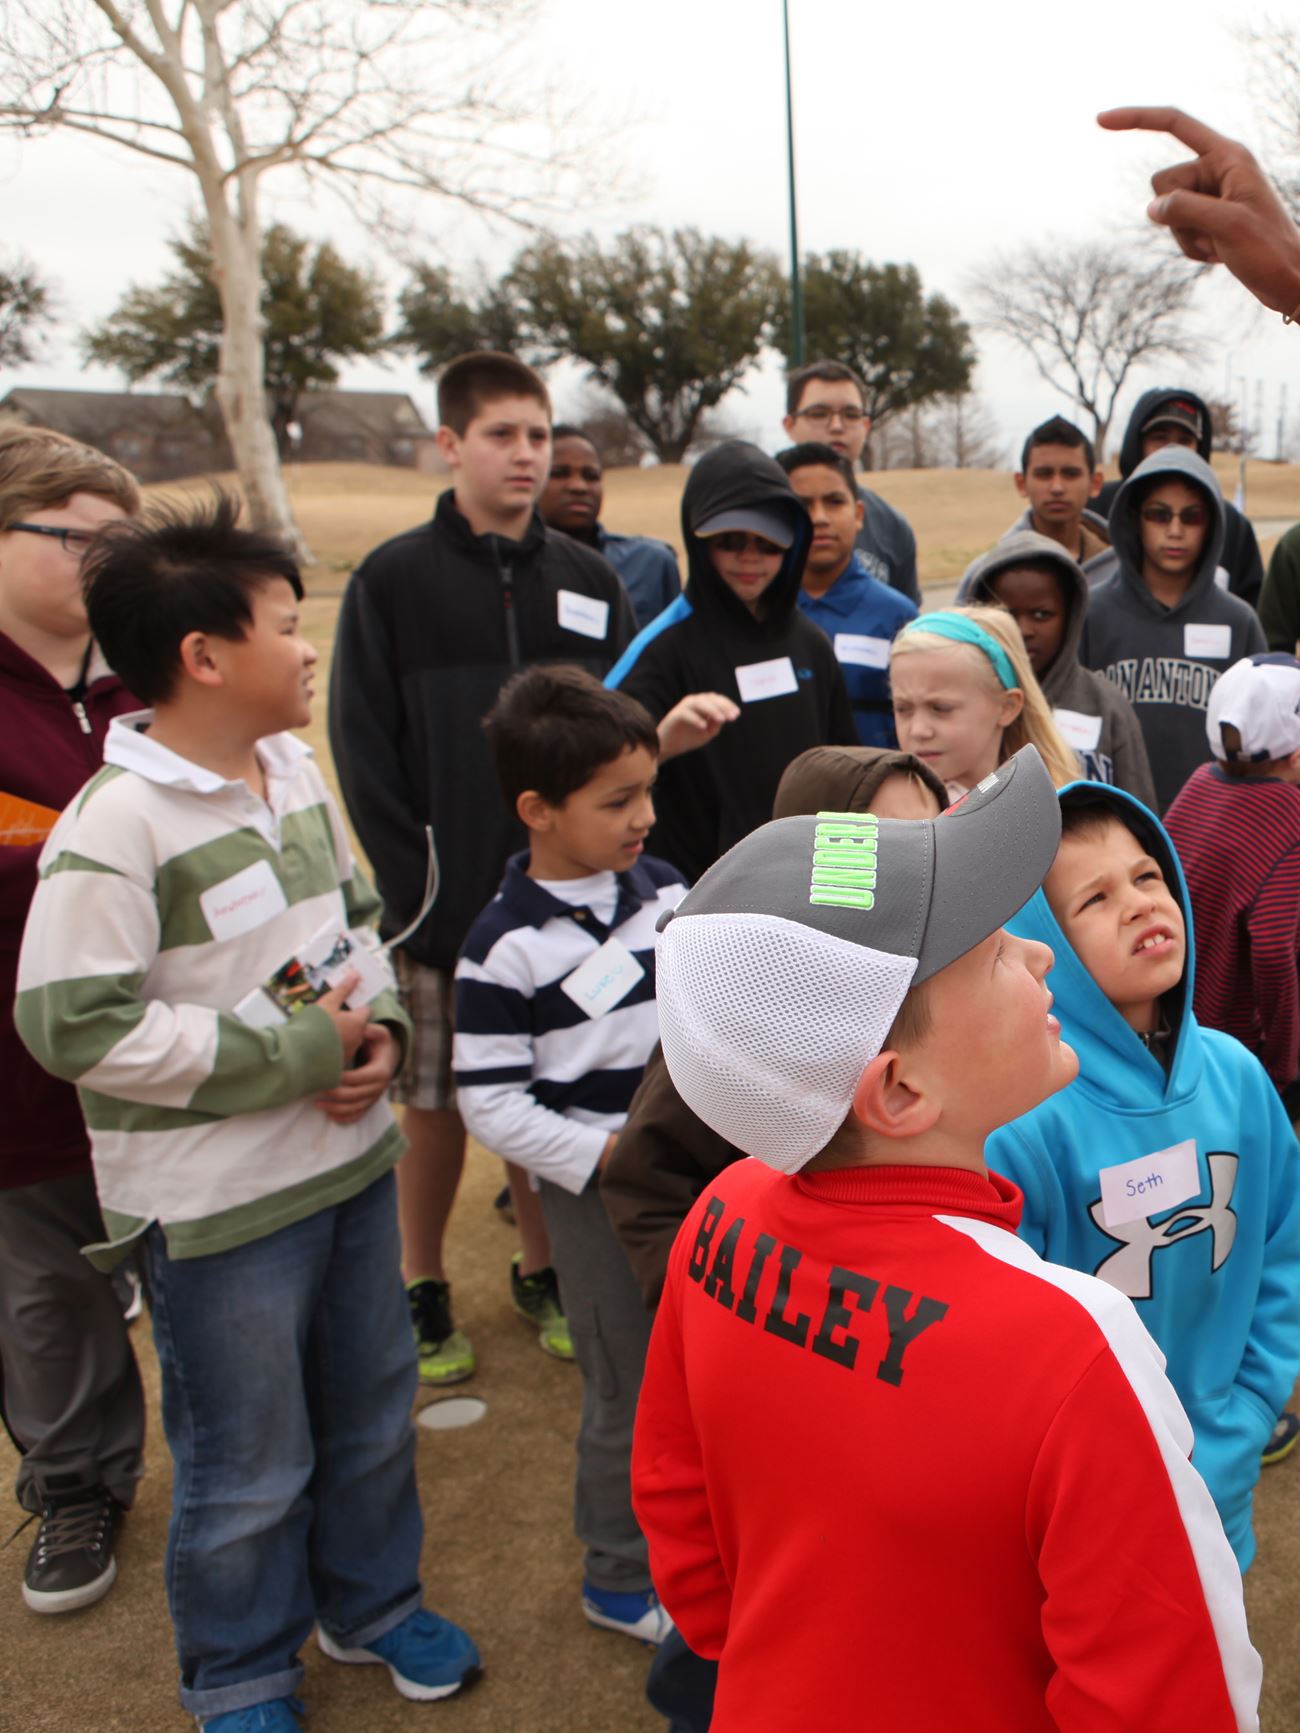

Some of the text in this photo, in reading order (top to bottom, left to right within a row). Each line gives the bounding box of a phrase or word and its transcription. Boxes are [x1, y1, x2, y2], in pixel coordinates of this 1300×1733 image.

[1136, 657, 1221, 711] ANTON
[809, 823, 879, 910] UNDER
[1126, 1173, 1163, 1196] Seth
[688, 1195, 949, 1387] BAILEY
